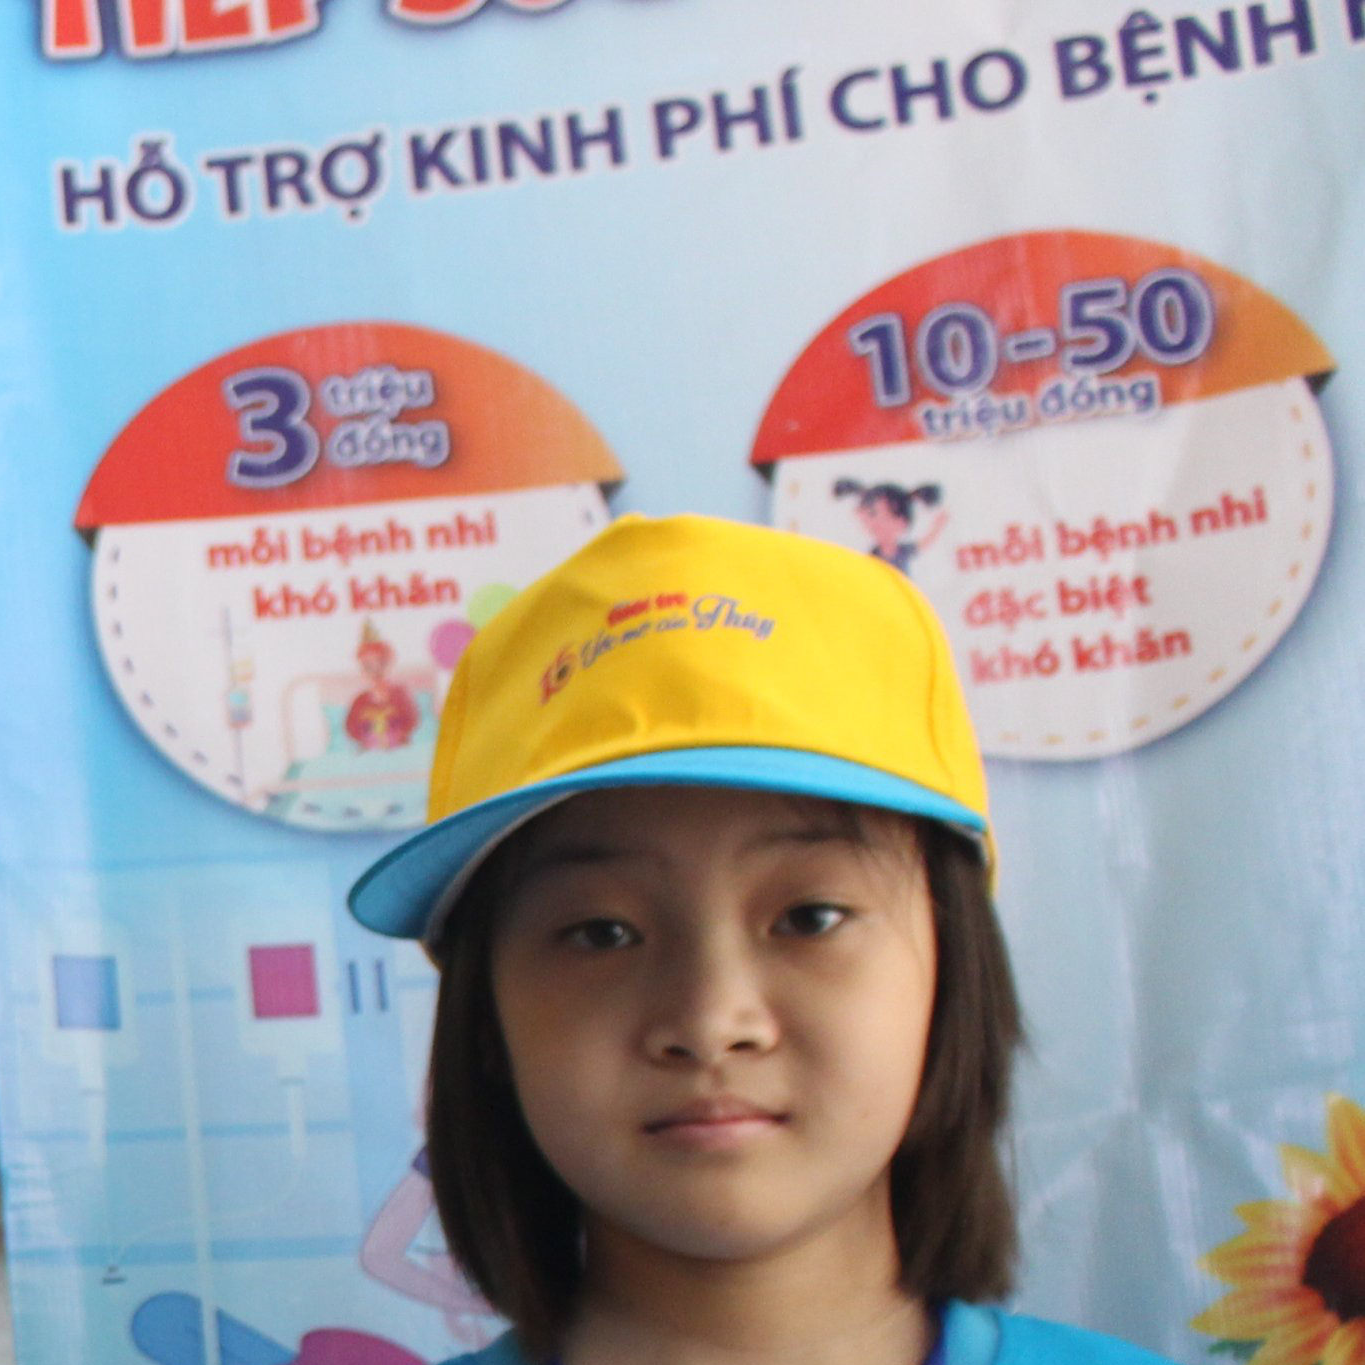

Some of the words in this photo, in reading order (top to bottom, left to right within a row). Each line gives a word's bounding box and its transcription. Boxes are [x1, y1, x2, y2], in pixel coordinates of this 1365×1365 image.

[58, 141, 187, 226] HỖ
[207, 135, 386, 221] TRỢ
[409, 107, 626, 192] KINH
[654, 66, 803, 158] PHÍ
[831, 49, 1027, 130] CHO
[1054, 2, 1316, 103] BỆNH
[323, 366, 434, 416] triệu
[922, 388, 1027, 437] triệu
[226, 368, 316, 484] 3
[207, 523, 288, 568] mỗi
[300, 519, 414, 564] bệnh
[427, 513, 497, 547] nhi
[957, 525, 1045, 571] mỗi
[1057, 512, 1178, 558] bệnh
[1190, 489, 1268, 532] nhi
[253, 579, 337, 619] khó
[351, 573, 460, 615] khăn
[963, 589, 1047, 627] đặc
[1057, 574, 1152, 617] biệt
[971, 641, 1060, 684] khó
[1073, 629, 1191, 672] khăn
